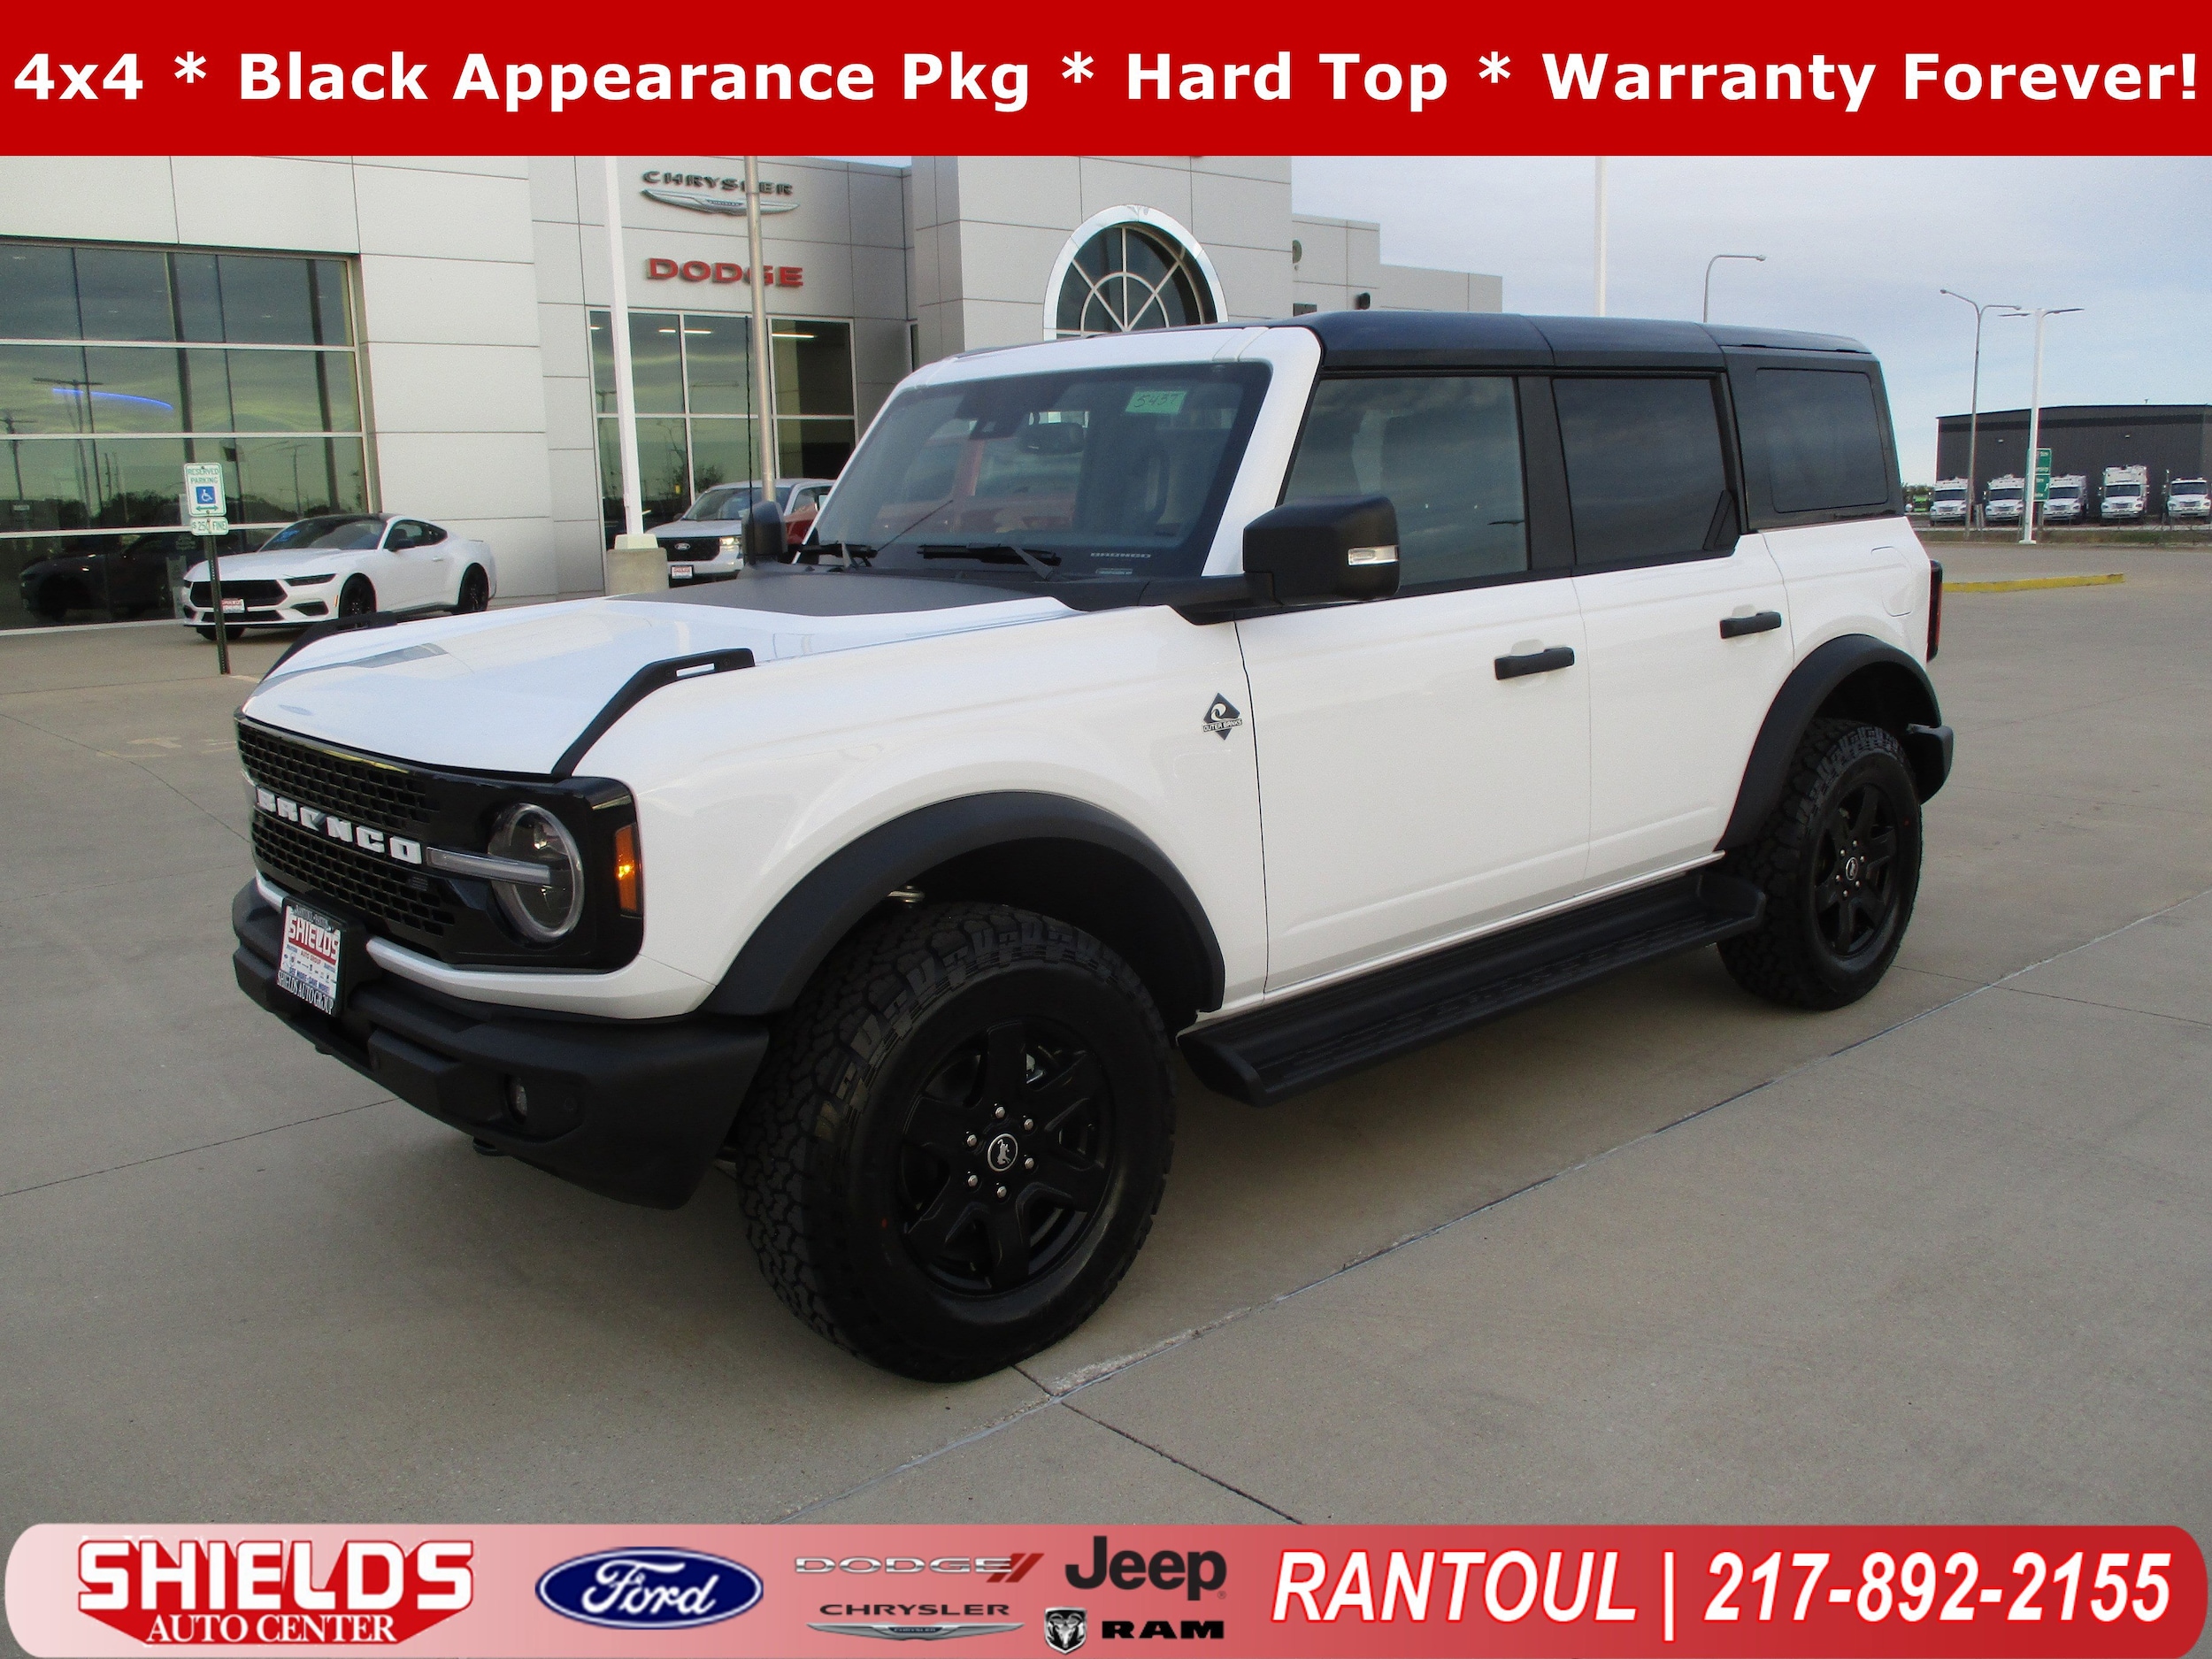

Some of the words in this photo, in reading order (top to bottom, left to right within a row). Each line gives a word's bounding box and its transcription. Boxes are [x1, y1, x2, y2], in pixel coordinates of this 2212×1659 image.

[212, 520, 227, 531] FINE
[1203, 721, 1223, 732] OUTER
[1223, 719, 1242, 728] BANKS
[288, 917, 340, 960] SHIELDS
[297, 981, 314, 1005] AUTO
